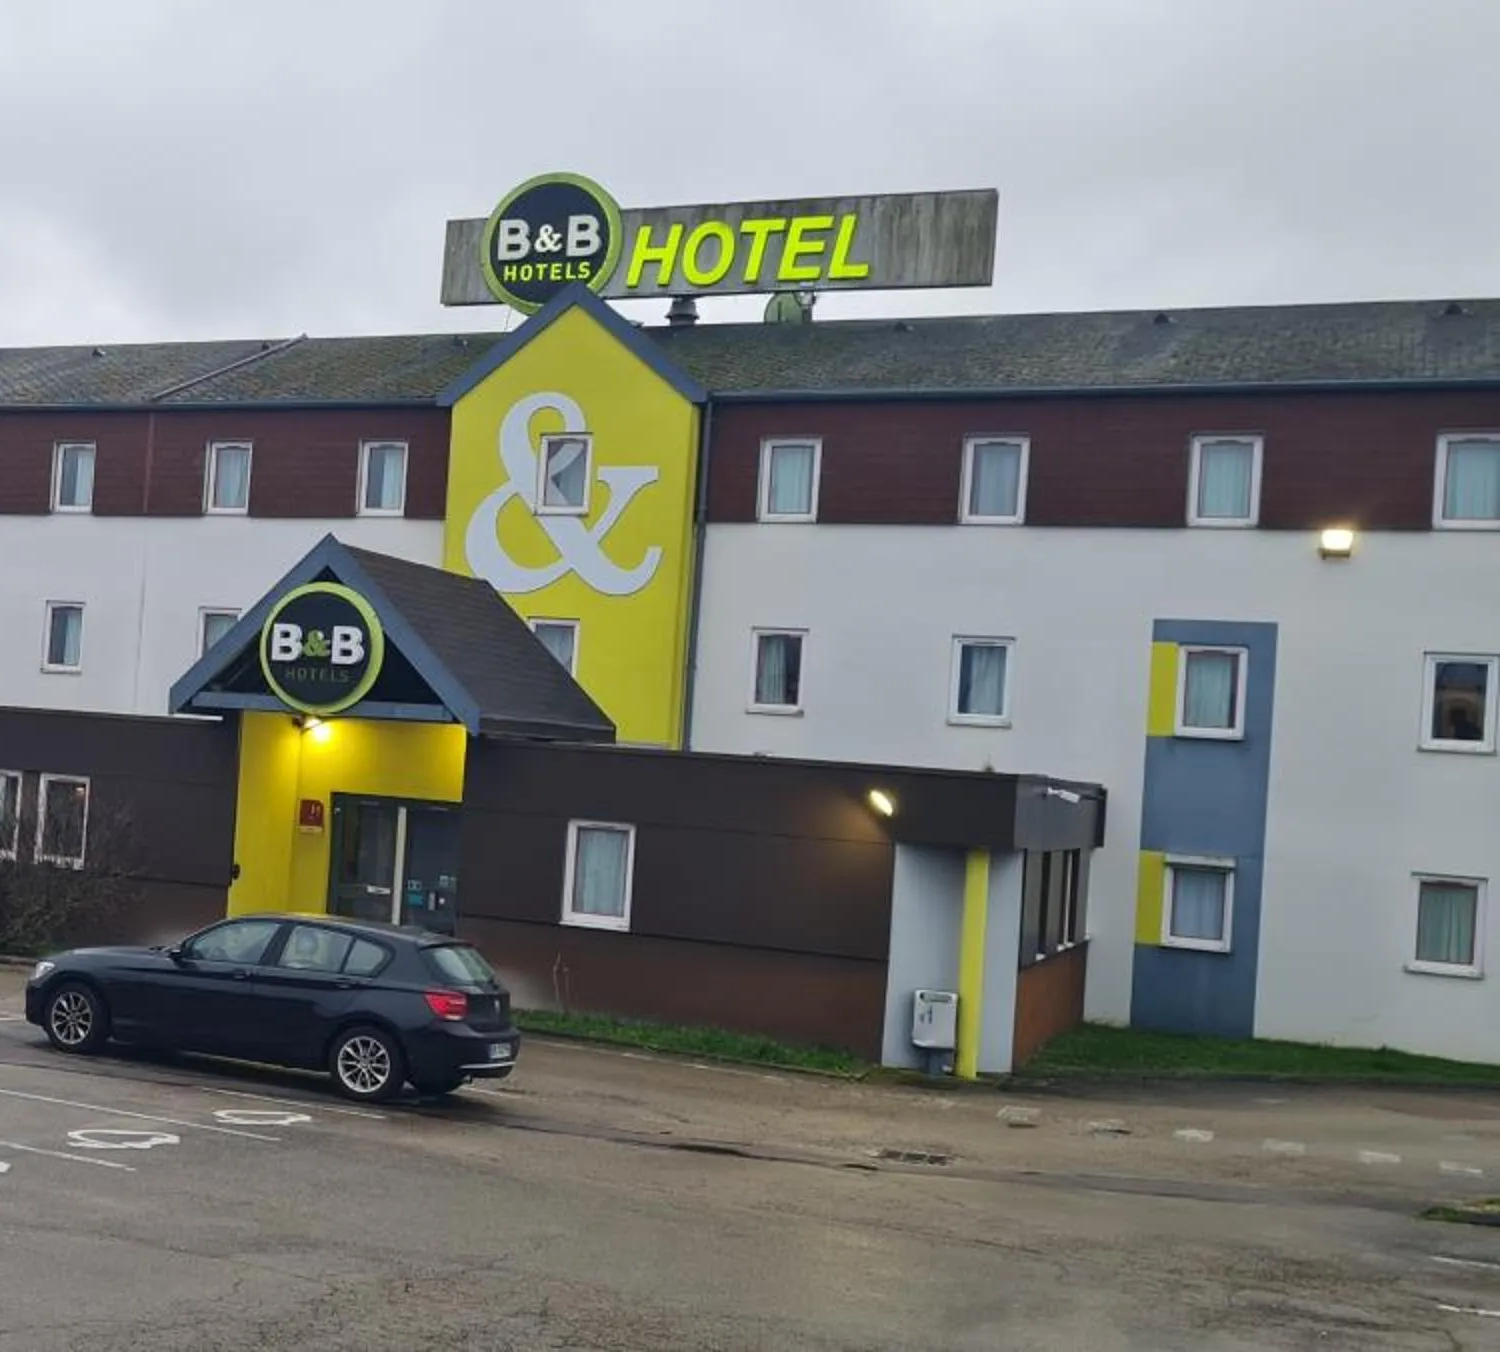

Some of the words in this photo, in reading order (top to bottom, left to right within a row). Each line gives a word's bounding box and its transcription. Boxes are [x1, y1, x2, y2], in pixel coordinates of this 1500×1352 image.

[497, 214, 601, 261] B&B
[626, 213, 870, 289] HOTEL
[503, 261, 592, 283] HOTELS
[465, 391, 663, 595] &
[271, 623, 365, 665] B&B
[287, 667, 350, 683] HOTELS
